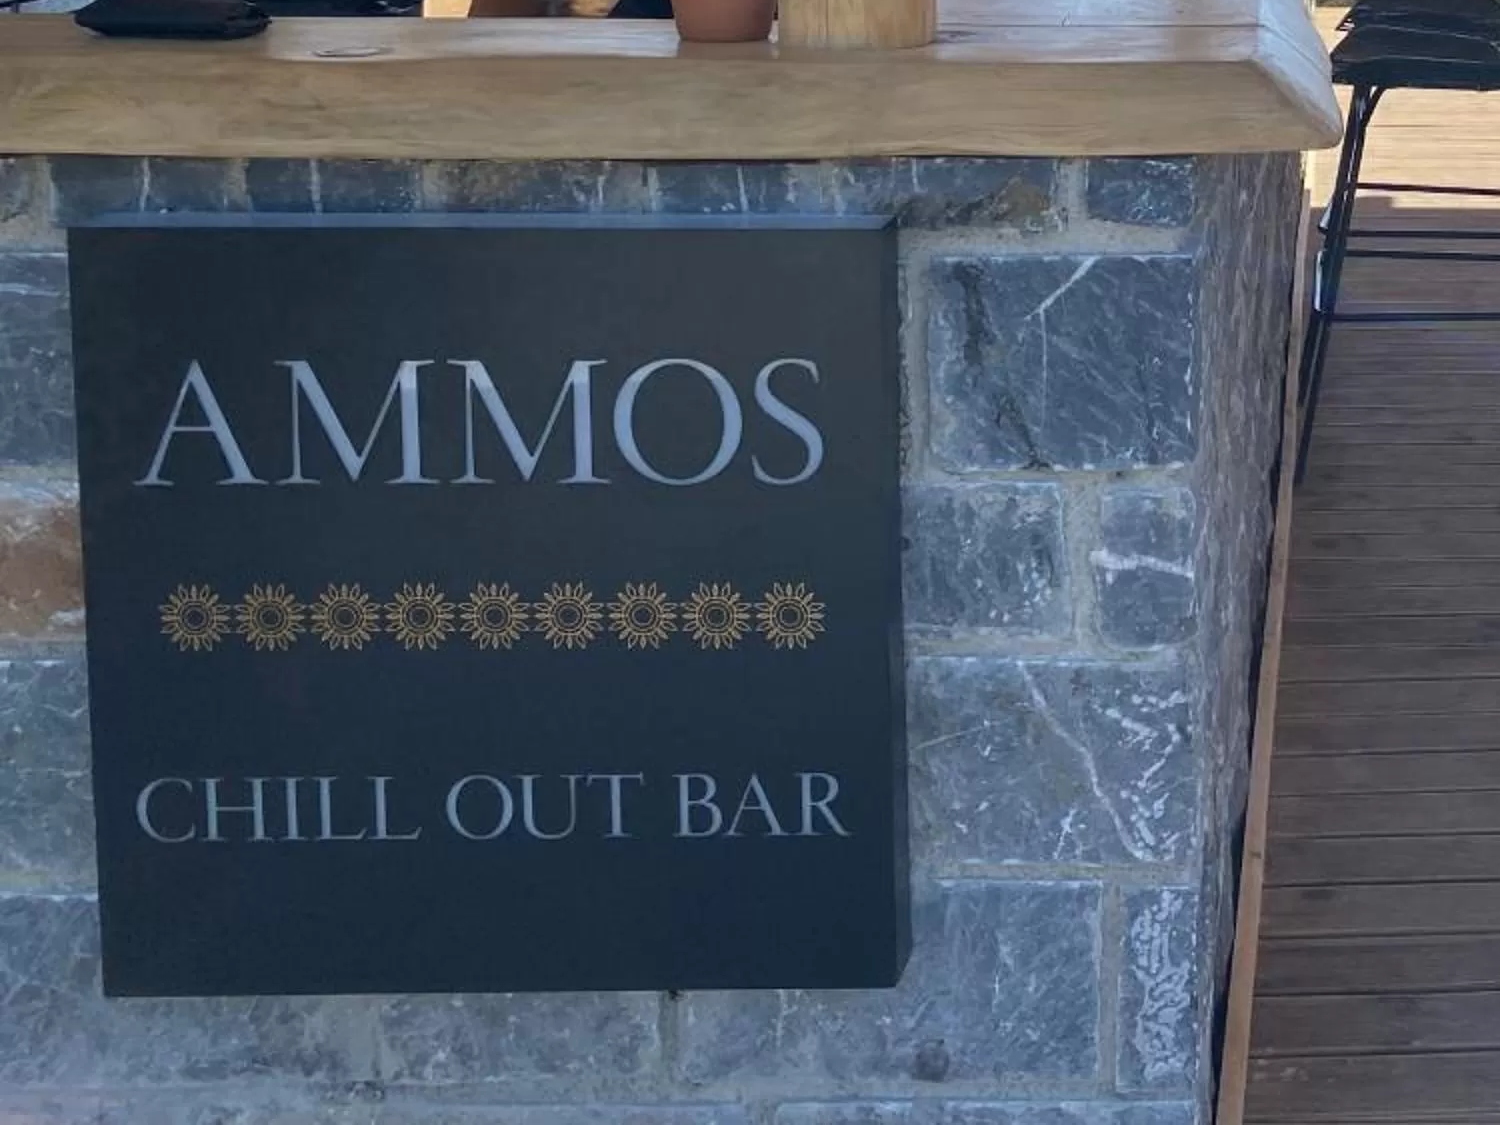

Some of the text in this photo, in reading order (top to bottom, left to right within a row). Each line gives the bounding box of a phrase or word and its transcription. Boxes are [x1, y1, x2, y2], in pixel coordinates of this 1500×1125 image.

[134, 357, 825, 486] AMMOS
[135, 771, 850, 843] CHILL OUT BAR
